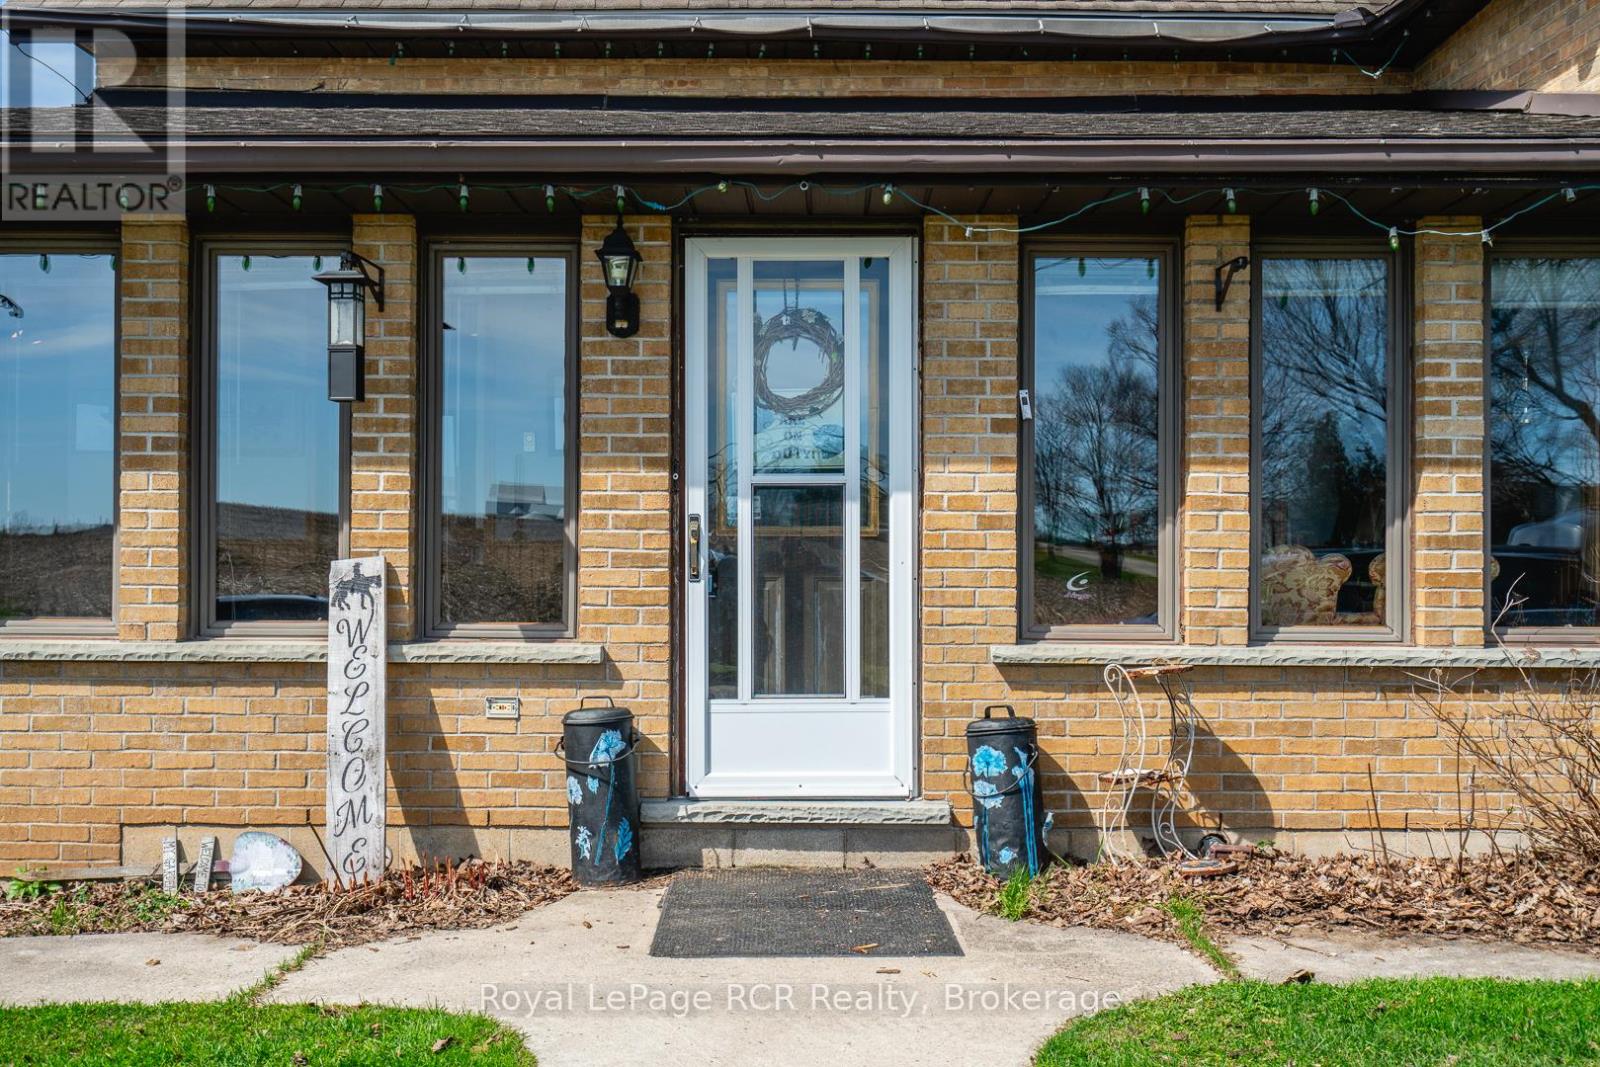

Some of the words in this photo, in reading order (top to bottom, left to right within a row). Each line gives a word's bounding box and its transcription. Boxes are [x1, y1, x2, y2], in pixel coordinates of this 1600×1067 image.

[334, 612, 374, 875] WELCOME
[197, 841, 214, 878] WELCOME
[194, 881, 208, 891] TO
